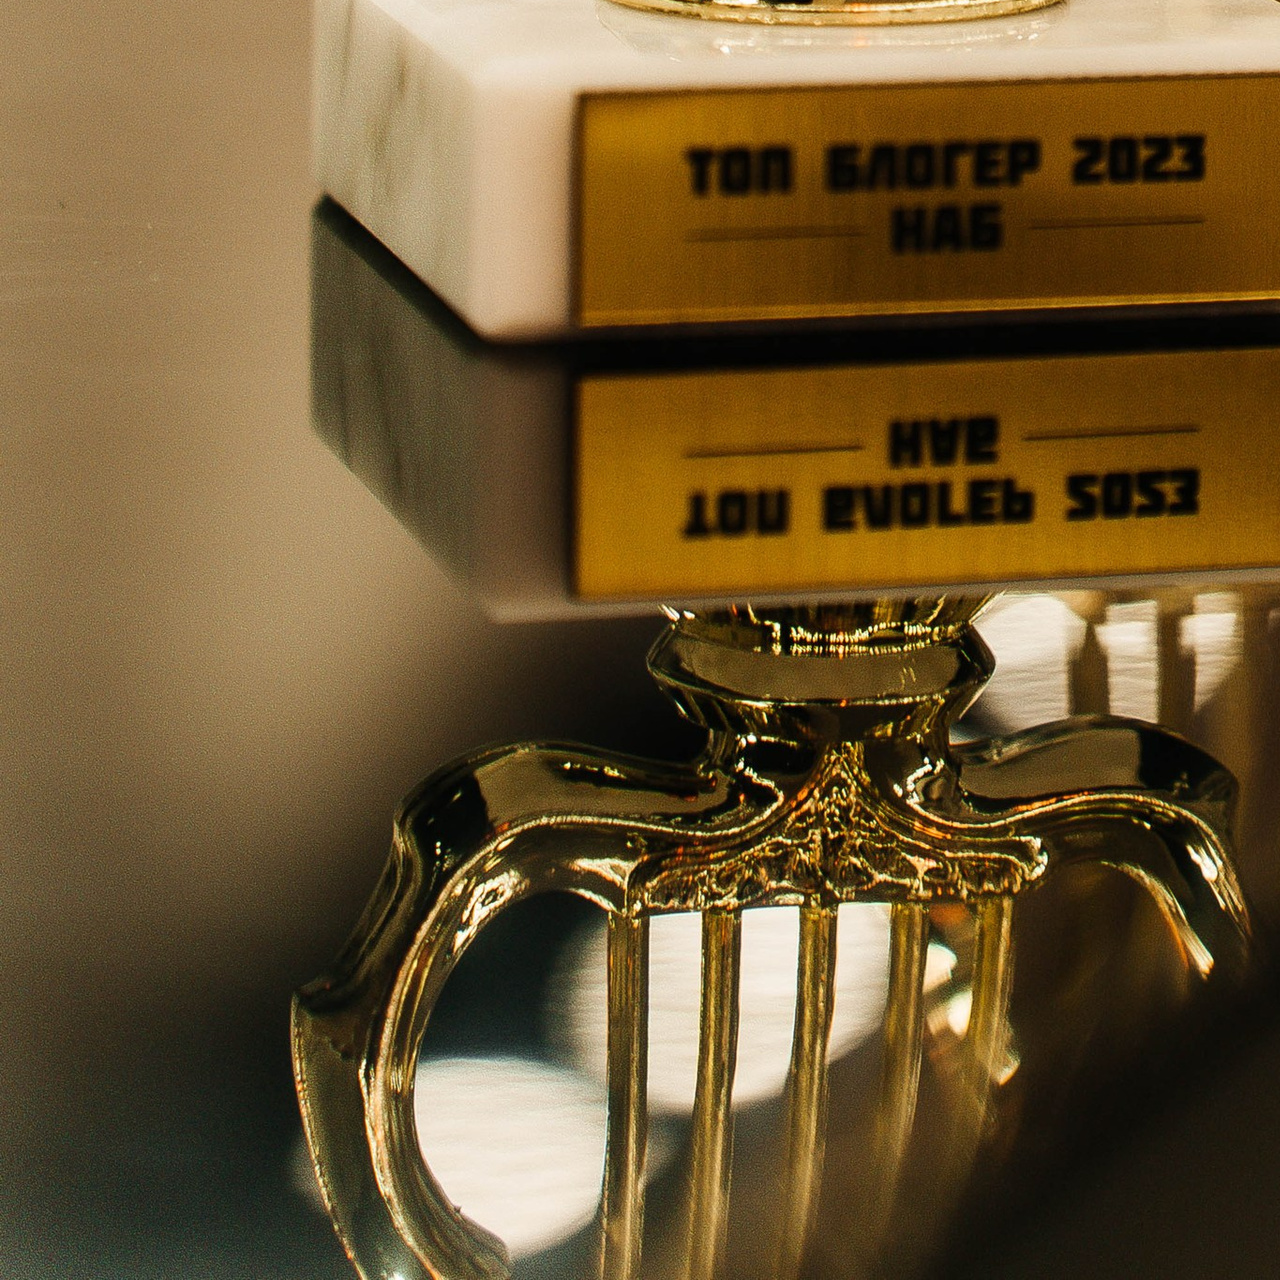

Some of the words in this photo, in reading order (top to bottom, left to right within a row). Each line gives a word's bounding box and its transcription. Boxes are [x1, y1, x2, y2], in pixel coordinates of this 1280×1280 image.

[685, 146, 795, 196] ТОП
[825, 139, 1042, 192] БЛОГЕР
[1071, 133, 1206, 185] 2023
[891, 204, 1004, 253] НАБ
